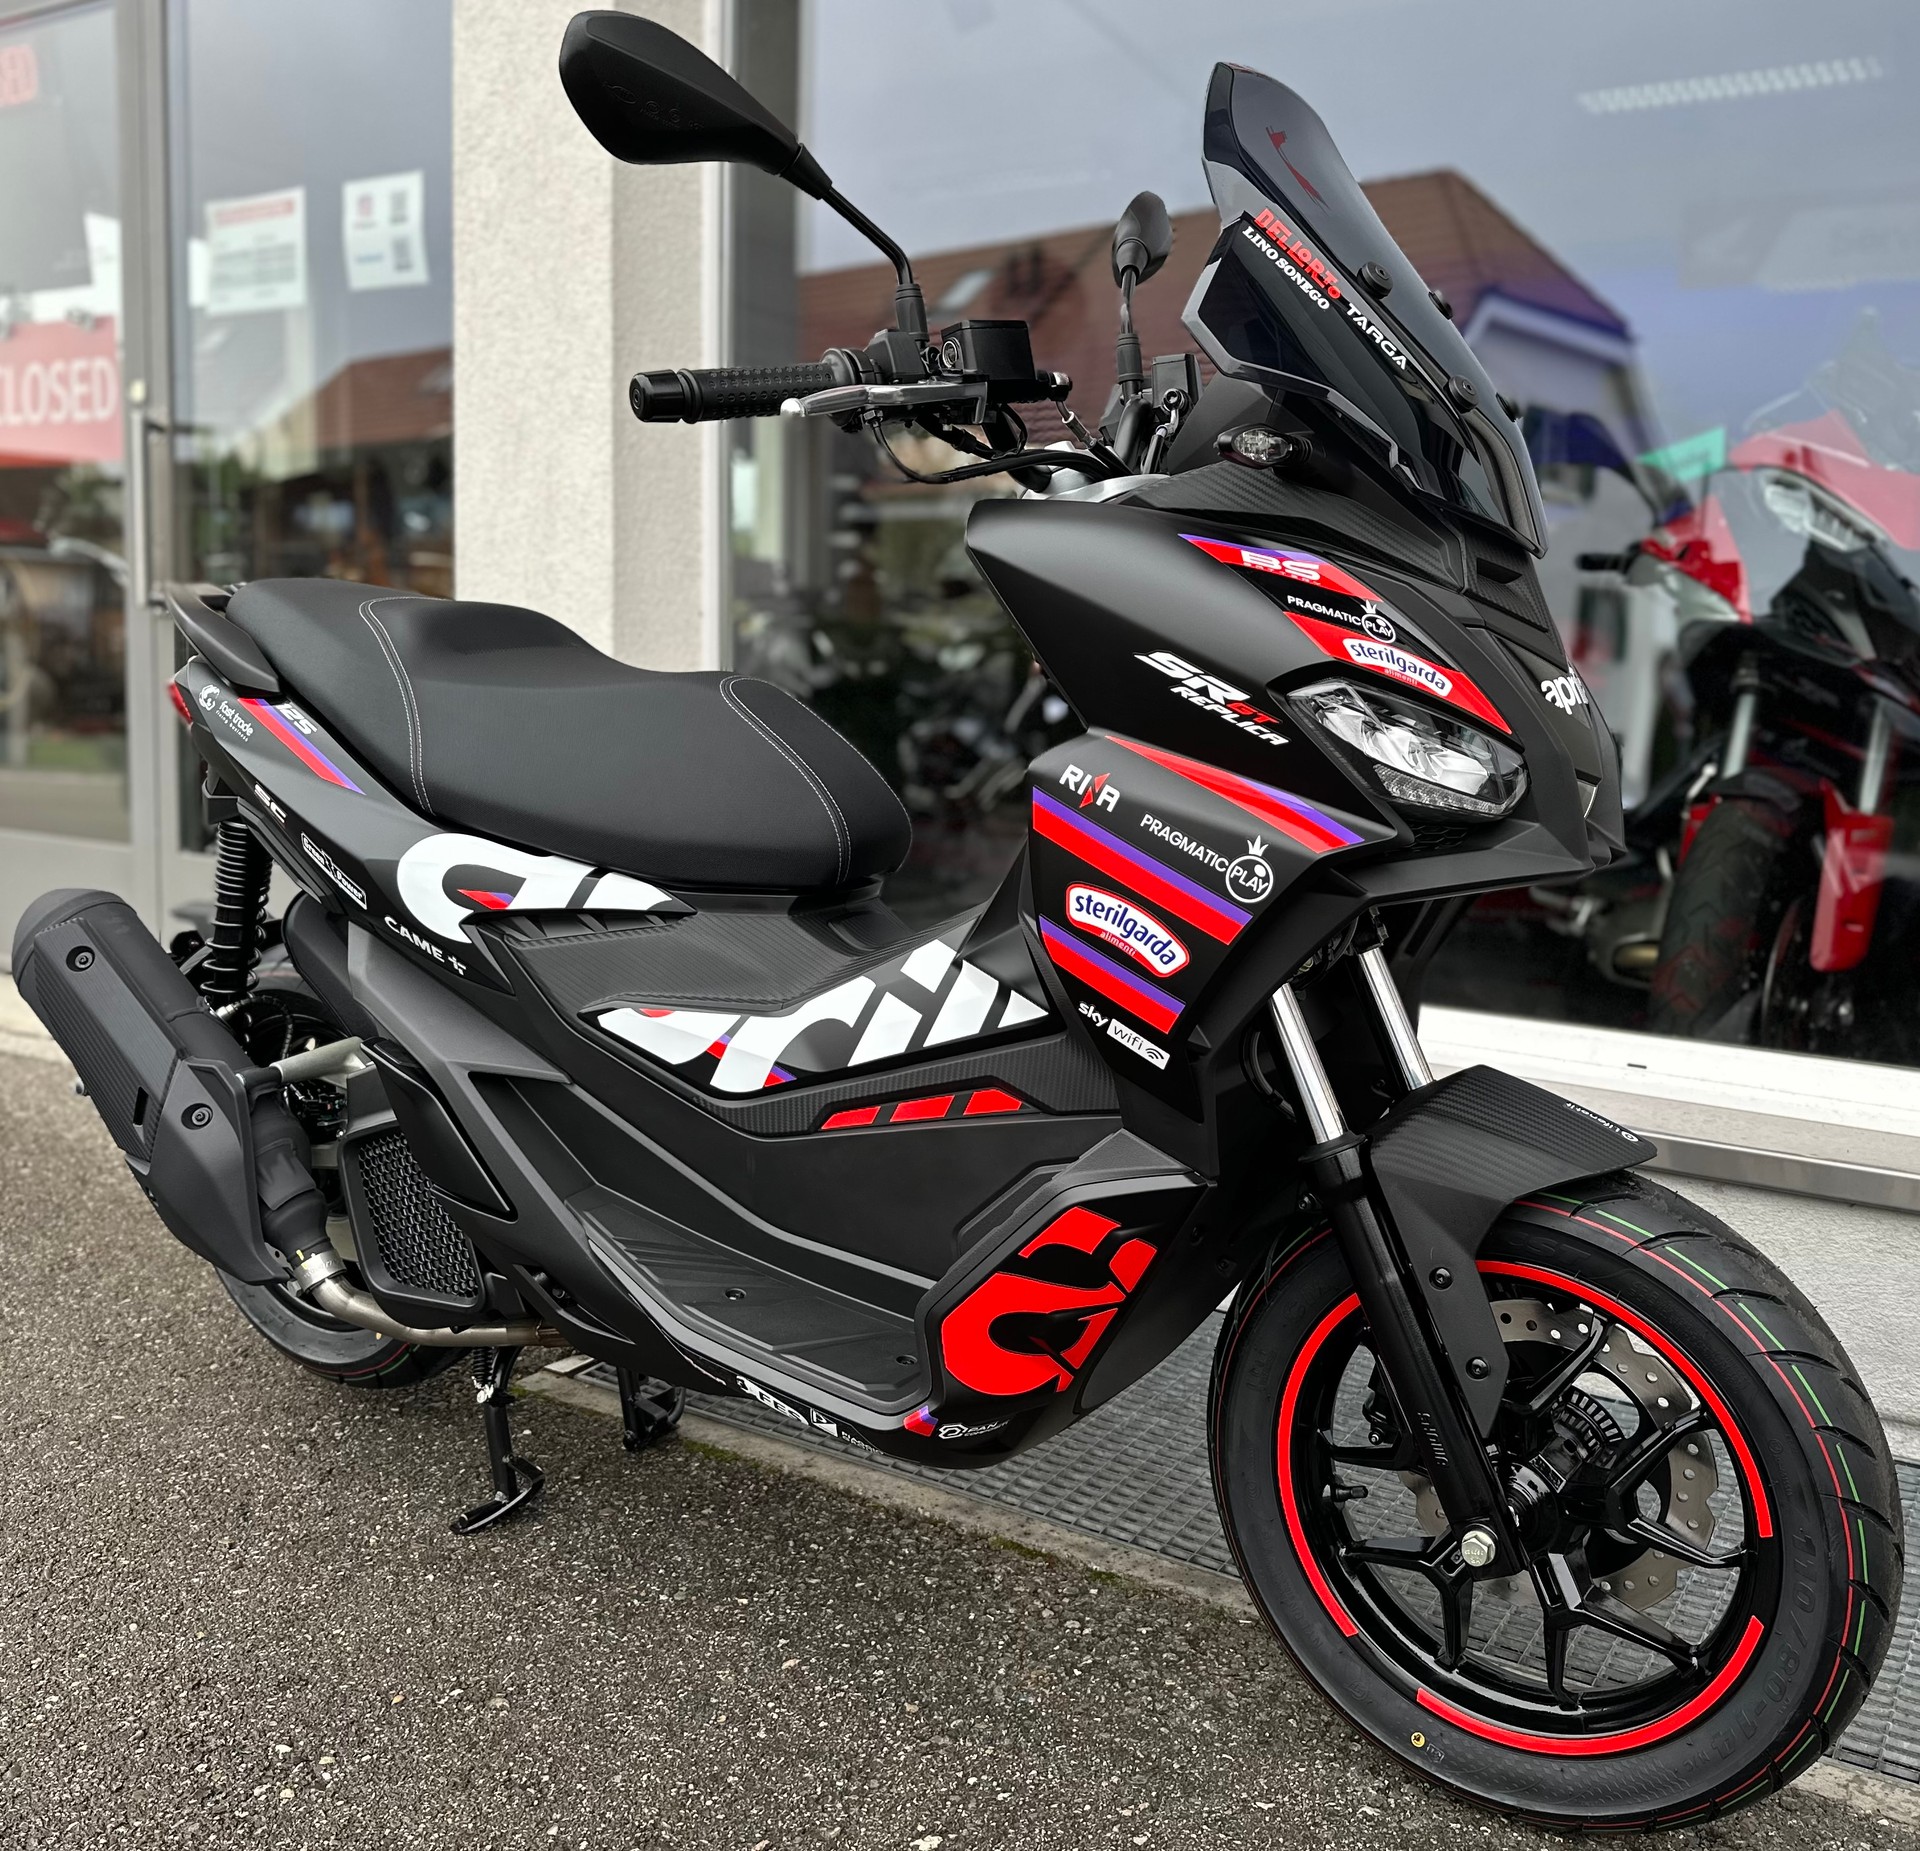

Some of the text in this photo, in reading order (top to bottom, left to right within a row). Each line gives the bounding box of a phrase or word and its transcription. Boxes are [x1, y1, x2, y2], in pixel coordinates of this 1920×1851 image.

[1242, 226, 1330, 310] LINO SONEGO
[1347, 302, 1408, 370] TARGA
[0, 355, 118, 427] LOSED
[1240, 550, 1321, 581] BS
[1287, 595, 1393, 638] PRAGMATIC PLAY
[1349, 641, 1447, 691] sterilgarda
[1383, 667, 1420, 687] alimenti
[218, 700, 255, 737] fast trade
[273, 703, 318, 735] 125
[1169, 686, 1290, 746] REPLICA
[253, 783, 288, 823] SC
[1139, 812, 1270, 895] PRAGMATIC PLAY
[384, 916, 445, 963] CAME
[1074, 892, 1178, 968] sterilgarda
[1098, 929, 1138, 957] alimenti
[1077, 1000, 1145, 1052] sky wifi
